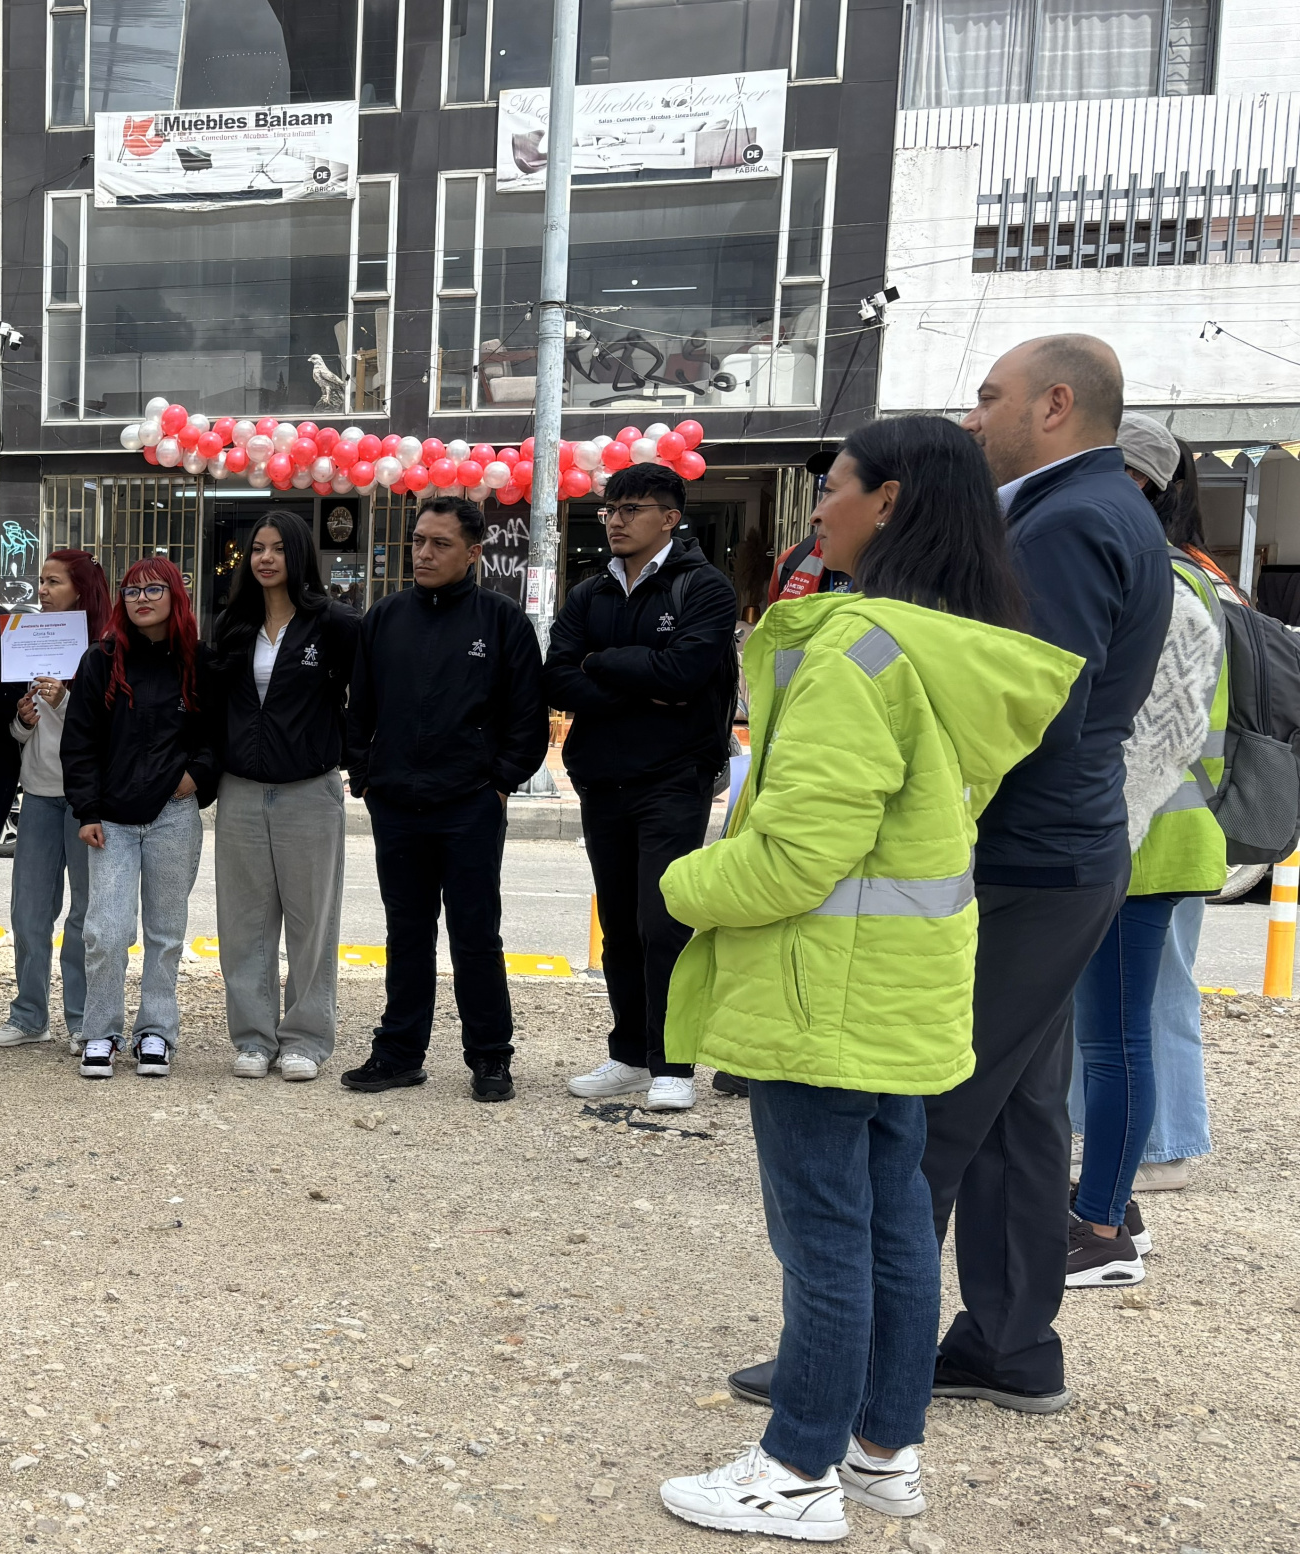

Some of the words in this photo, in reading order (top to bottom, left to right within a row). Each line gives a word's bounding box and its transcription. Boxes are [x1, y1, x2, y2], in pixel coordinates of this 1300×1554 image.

[163, 113, 247, 133] Muebles
[254, 110, 333, 128] Balaam
[201, 133, 238, 141] Comedores
[243, 132, 269, 140] Alcobas
[746, 150, 760, 159] DE
[316, 171, 328, 180] DE
